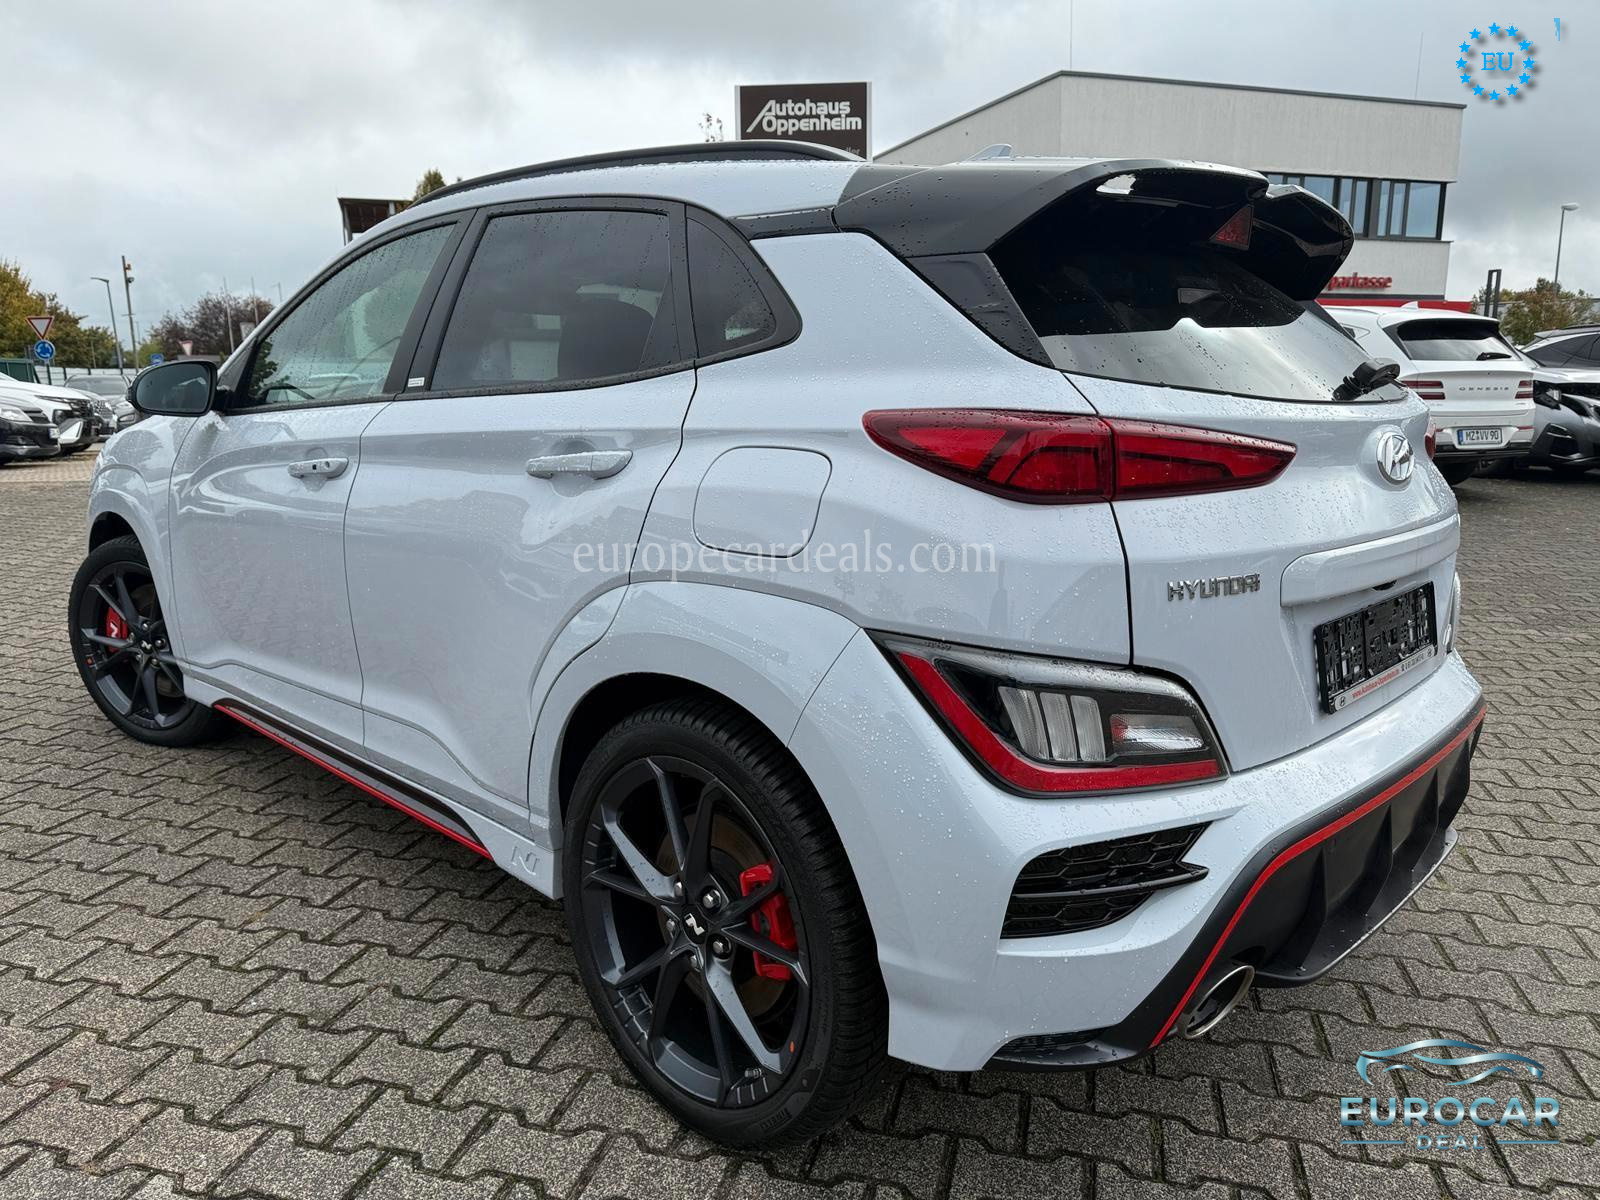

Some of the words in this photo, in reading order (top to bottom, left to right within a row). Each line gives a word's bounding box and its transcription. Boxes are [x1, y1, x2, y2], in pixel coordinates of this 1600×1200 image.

[762, 115, 862, 136] Oppenheim
[1328, 272, 1393, 290] parkasse
[1168, 573, 1260, 601] HYUNDAI
